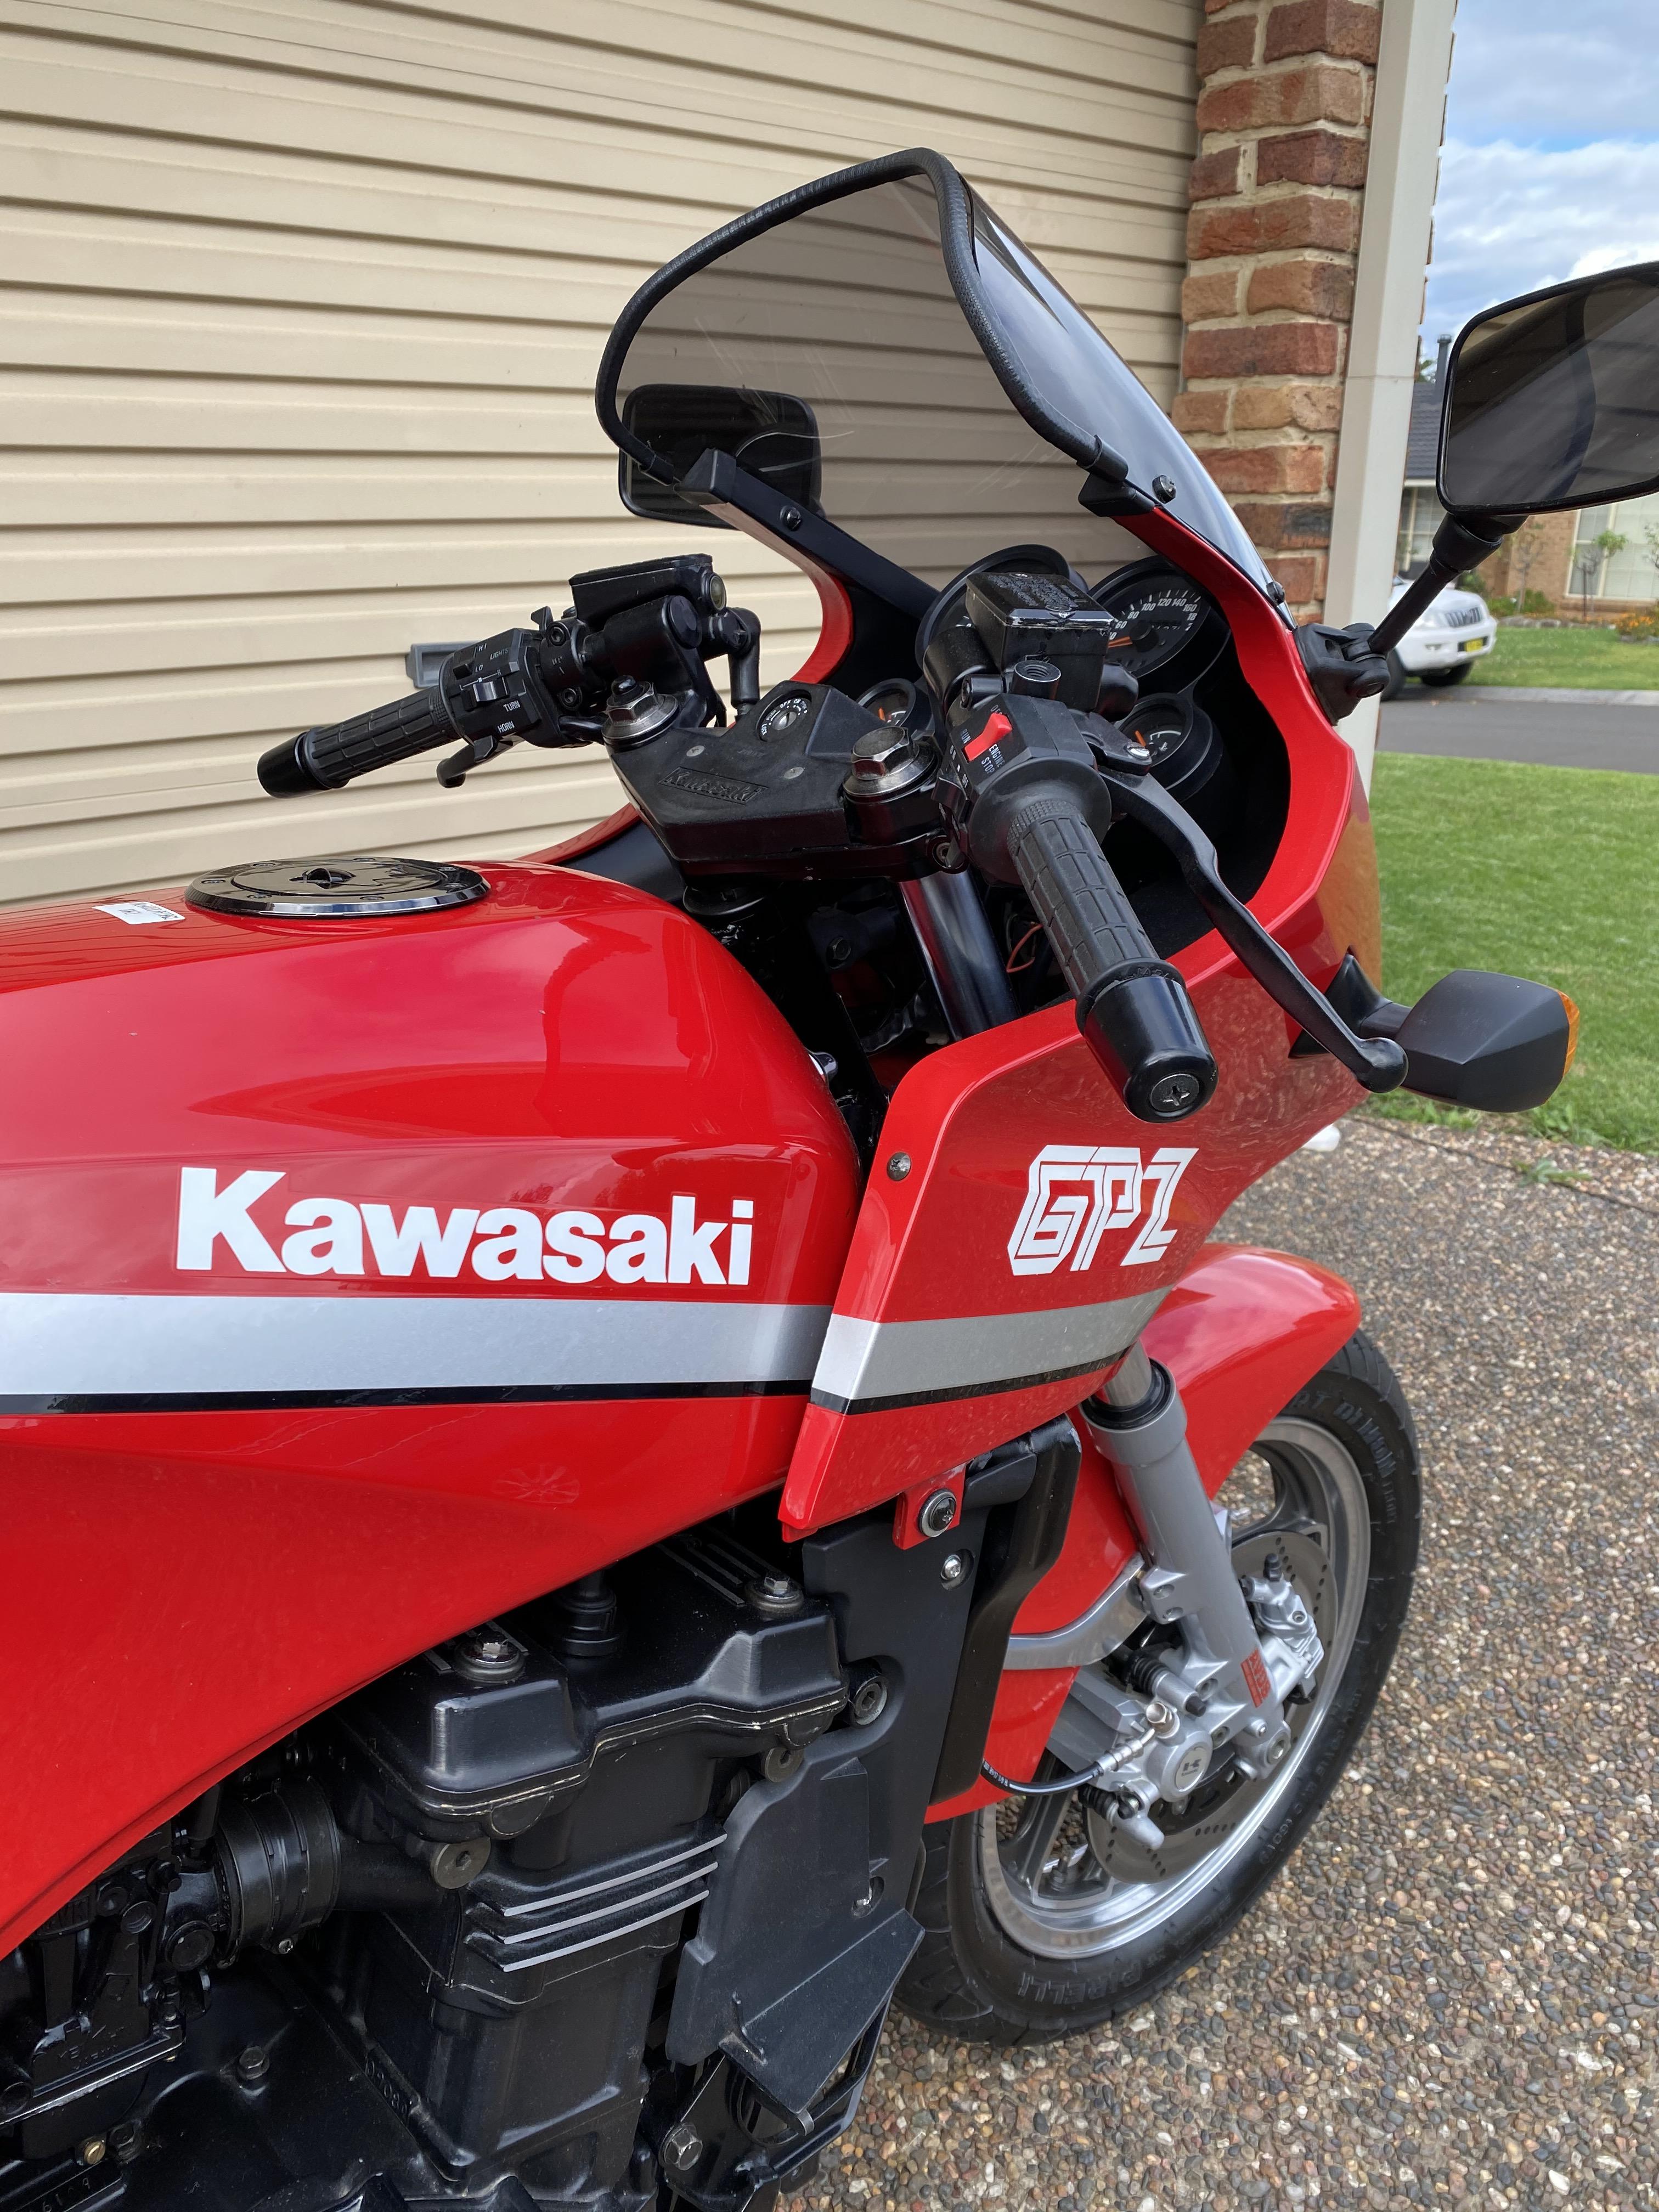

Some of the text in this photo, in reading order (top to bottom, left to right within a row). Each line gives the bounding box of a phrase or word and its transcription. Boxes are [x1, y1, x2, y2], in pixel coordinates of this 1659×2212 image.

[1141, 603, 1156, 611] 100
[1157, 598, 1172, 606] 120
[1171, 598, 1187, 606] 140
[1182, 603, 1198, 612] 160
[1127, 611, 1140, 619] 80
[1187, 613, 1198, 621] 18
[1115, 620, 1127, 629] 60
[478, 643, 487, 652] HI
[490, 648, 509, 660] LIGHTS
[475, 664, 483, 673] LO
[503, 700, 521, 712] TURN
[990, 704, 1002, 715] OF
[497, 720, 515, 733] HORN
[961, 729, 972, 744] RUN
[989, 743, 1006, 768] ENGINE
[981, 757, 995, 774] STOP
[1006, 1144, 1199, 1276] GPZ
[176, 1166, 754, 1286] Kawasaki
